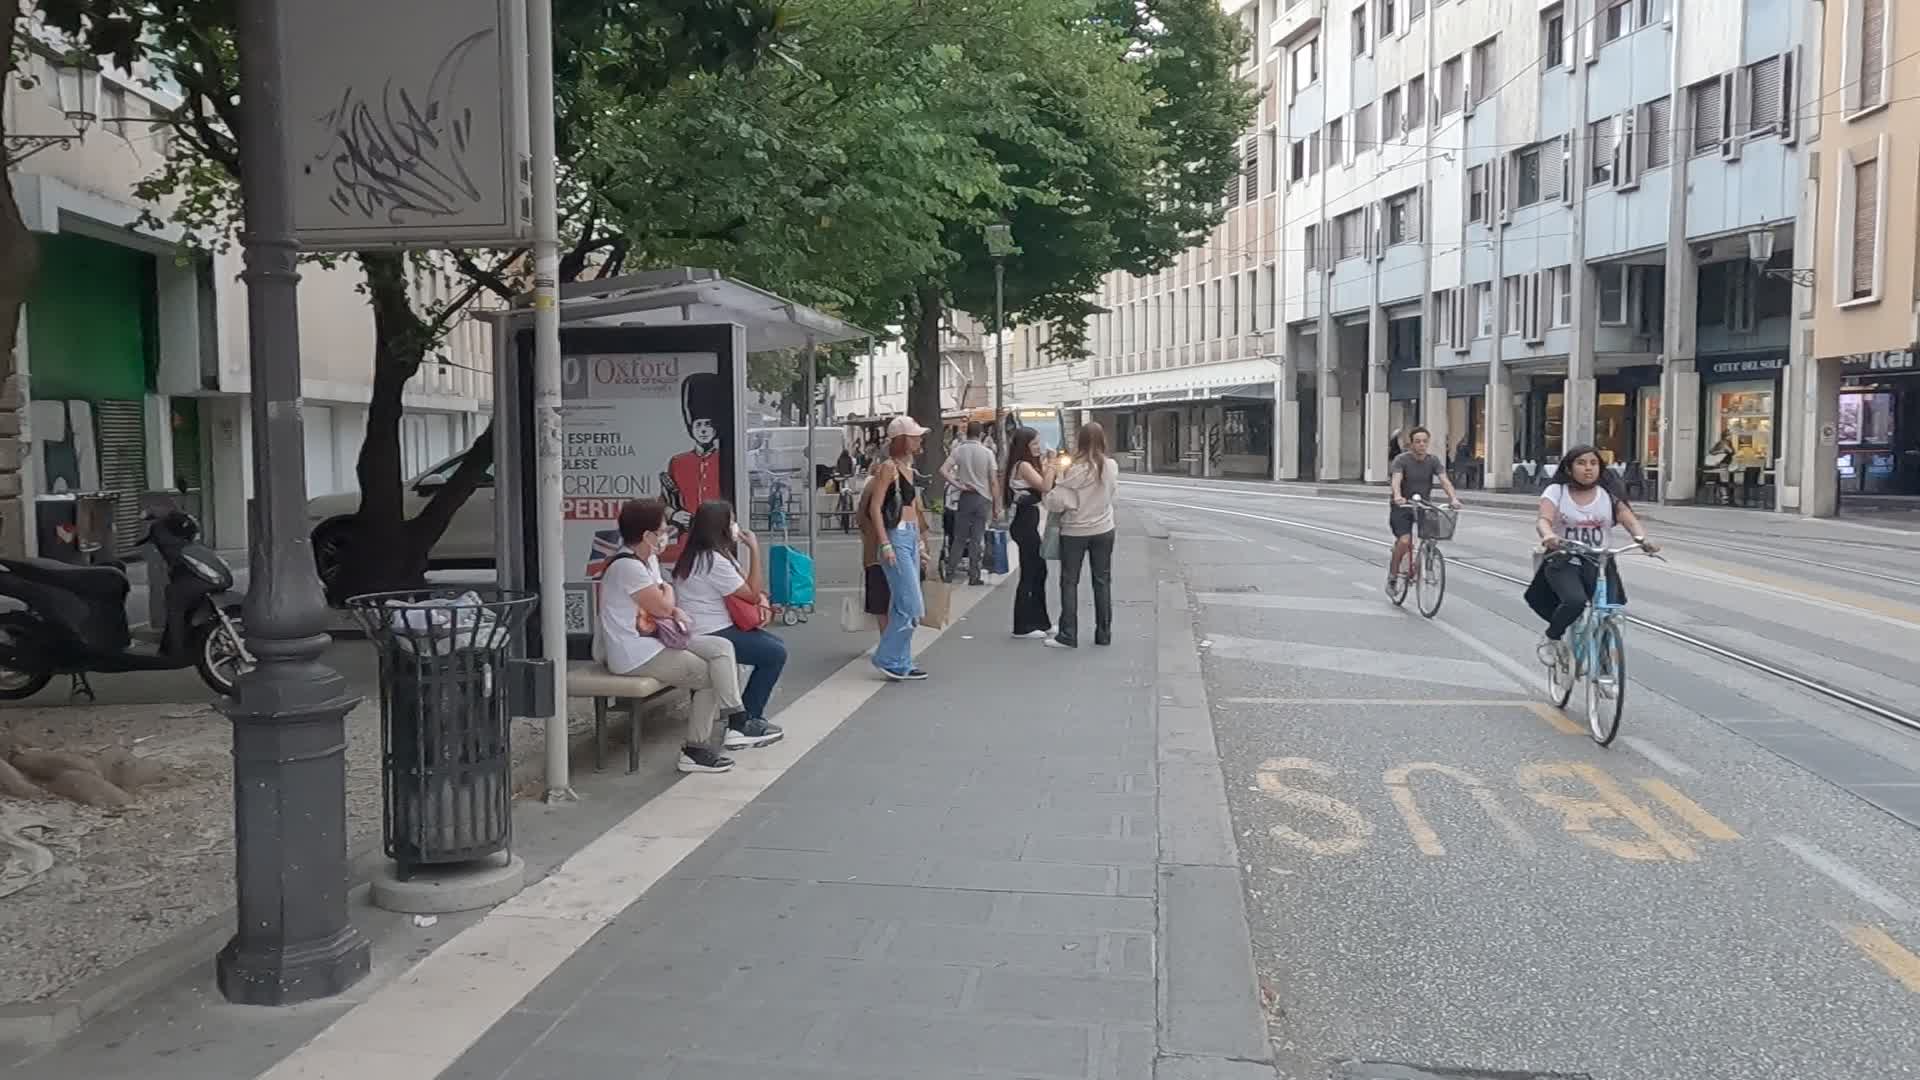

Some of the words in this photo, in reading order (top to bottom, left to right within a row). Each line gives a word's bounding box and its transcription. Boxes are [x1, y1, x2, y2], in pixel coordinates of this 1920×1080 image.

[594, 357, 679, 385] Oxford
[568, 432, 621, 444] ESPERTI
[588, 445, 636, 457] LINGUA
[561, 458, 598, 470] GLESE
[562, 474, 650, 495] CRIZIONI
[562, 499, 622, 519] PERT
[1255, 757, 1702, 862] BUS
